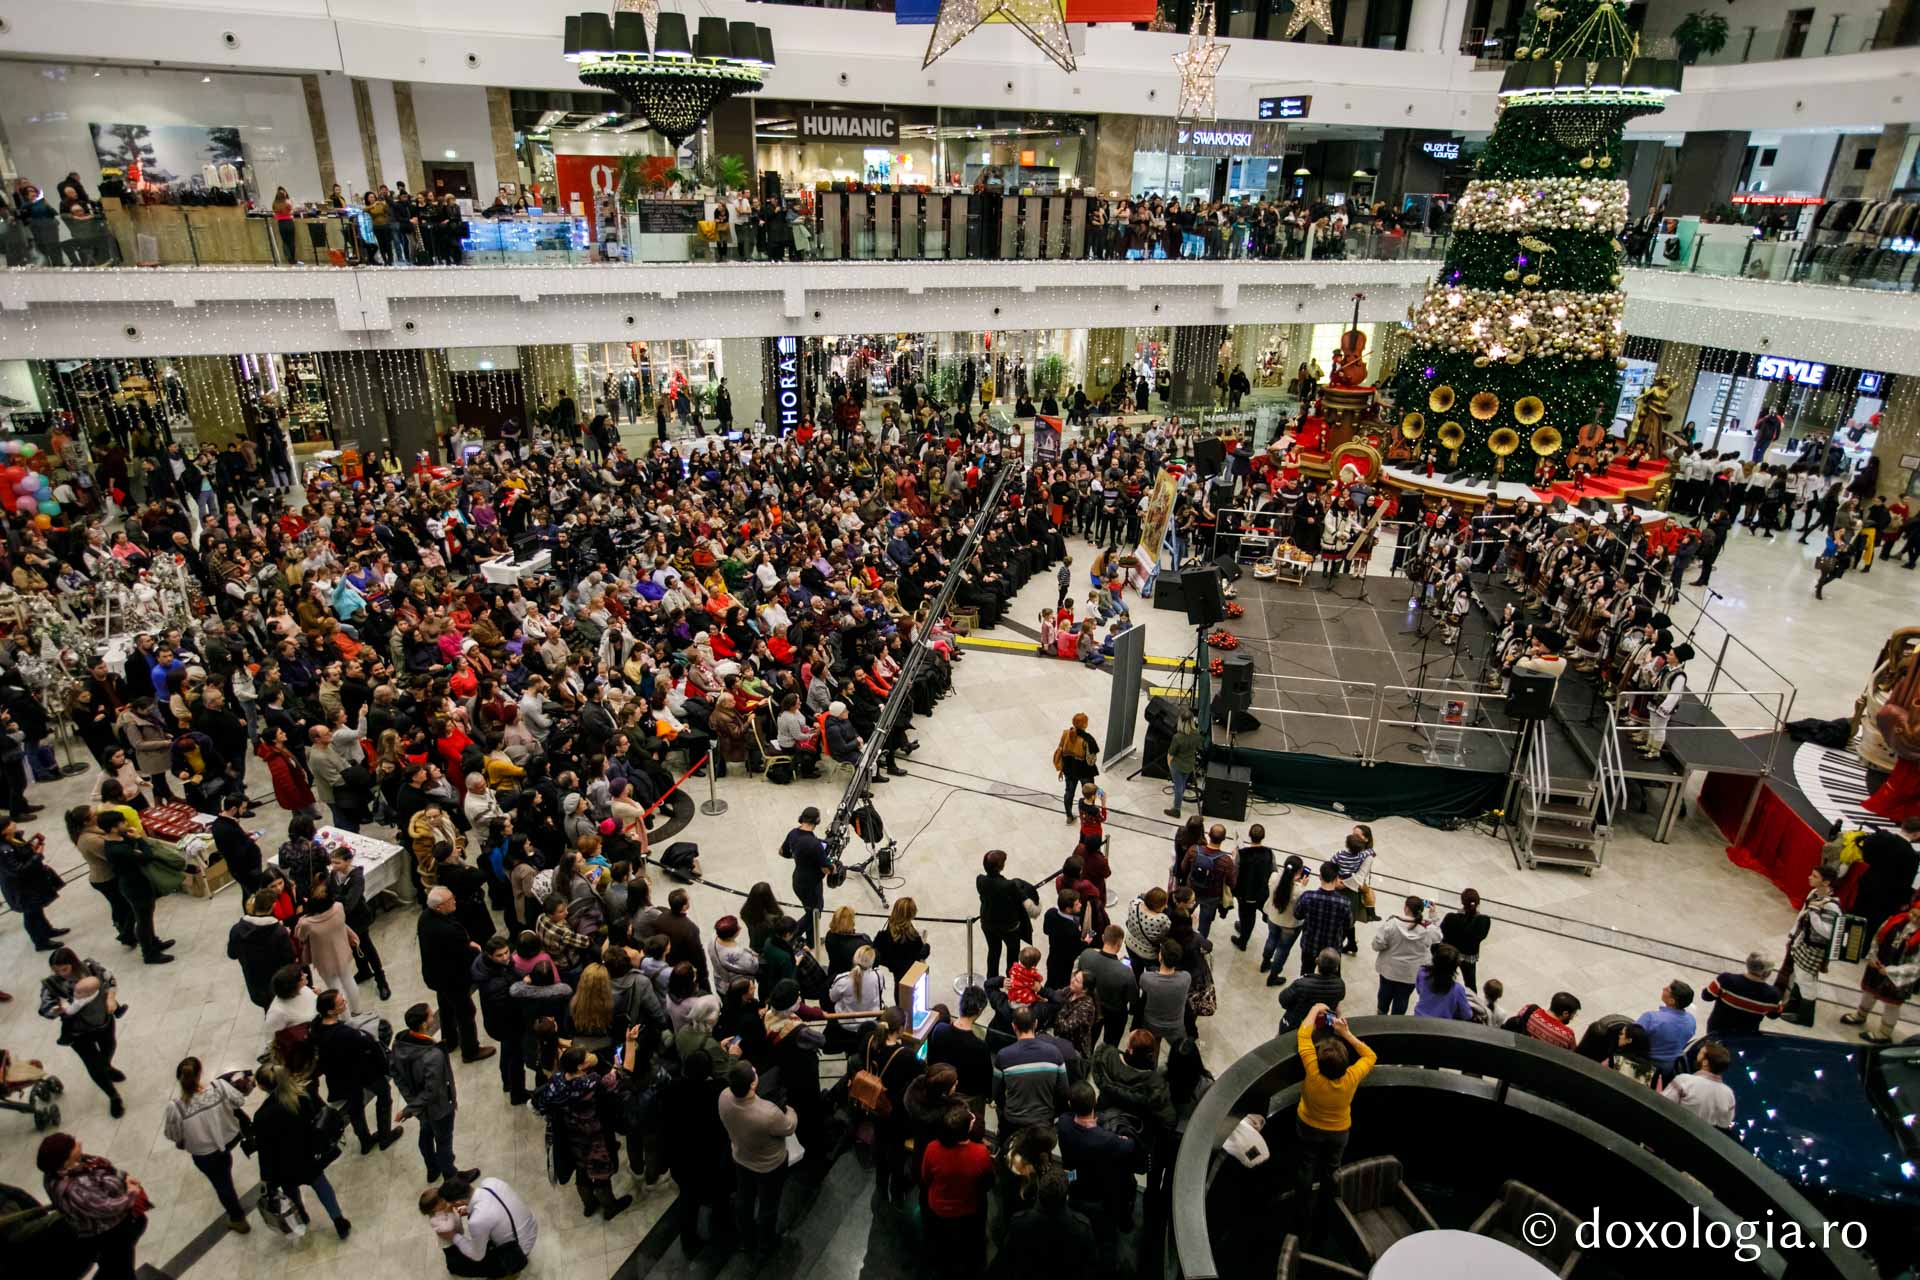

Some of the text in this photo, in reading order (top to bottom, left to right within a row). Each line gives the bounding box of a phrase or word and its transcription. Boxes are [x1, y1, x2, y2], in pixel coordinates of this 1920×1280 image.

[803, 116, 895, 138] HUMANIC
[1193, 132, 1252, 146] SWAROVSKI
[1757, 356, 1825, 385] iSTYLE
